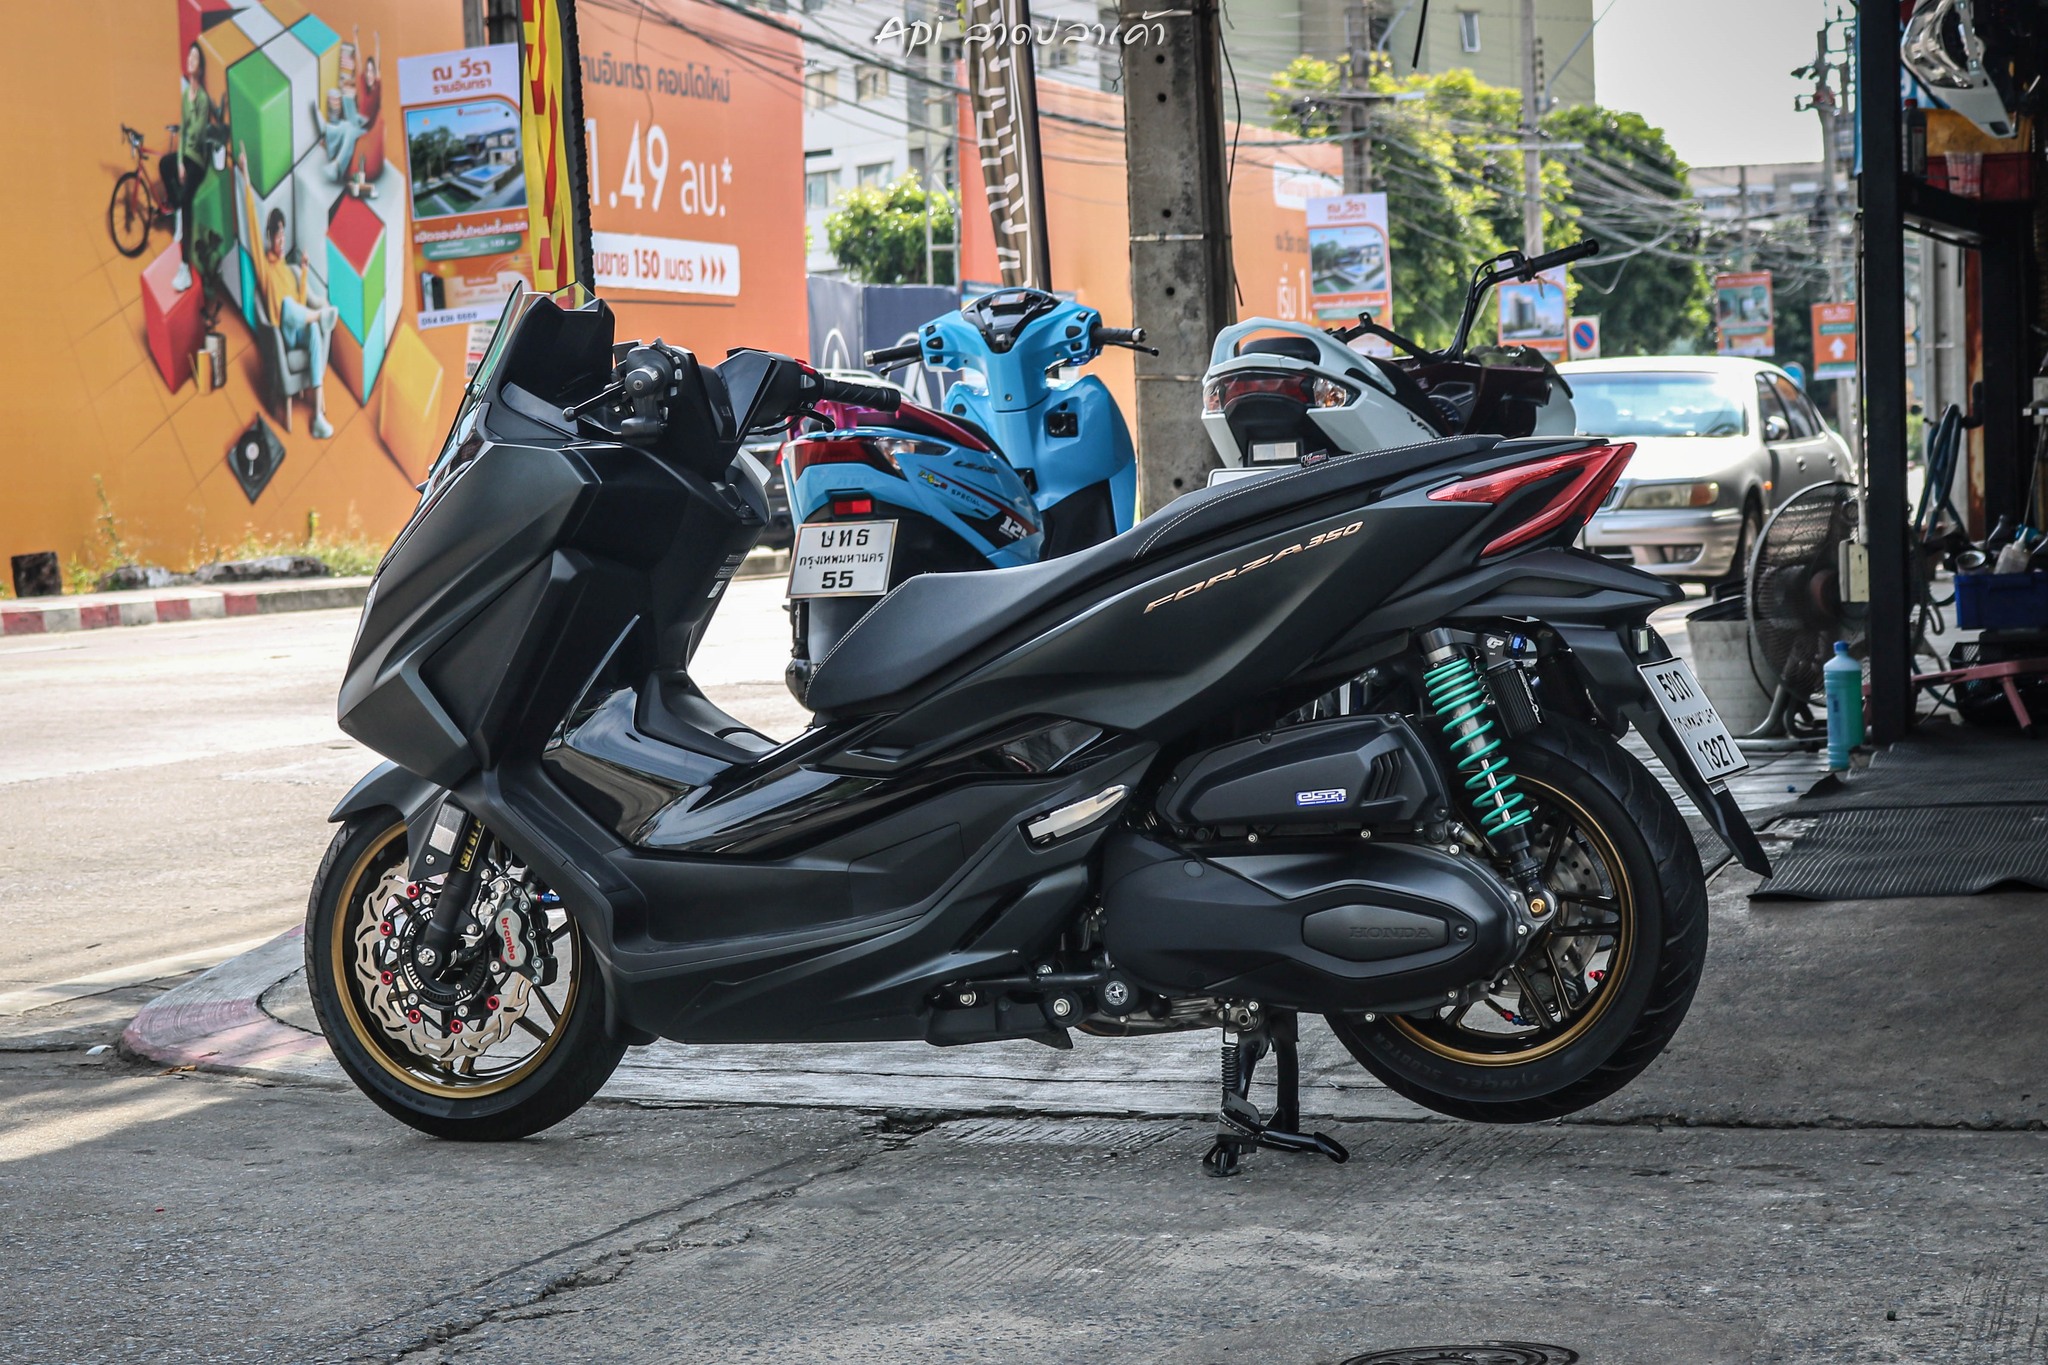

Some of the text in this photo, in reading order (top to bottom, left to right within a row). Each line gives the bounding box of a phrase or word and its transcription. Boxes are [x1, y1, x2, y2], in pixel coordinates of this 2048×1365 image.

[432, 58, 492, 81] ณ วีรา
[657, 62, 731, 103] คอนโดใหม่
[585, 117, 669, 213] 1.49
[633, 248, 661, 279] 150
[664, 256, 694, 282] เมตร
[951, 488, 981, 507] SPECIAL
[799, 552, 885, 570] กรุงเทพมหานคร
[1143, 520, 1364, 615] FORZA 350
[821, 570, 855, 590] 55
[1696, 734, 1735, 771] 1327
[501, 916, 516, 961] brembo
[1349, 926, 1435, 939] HONDA
